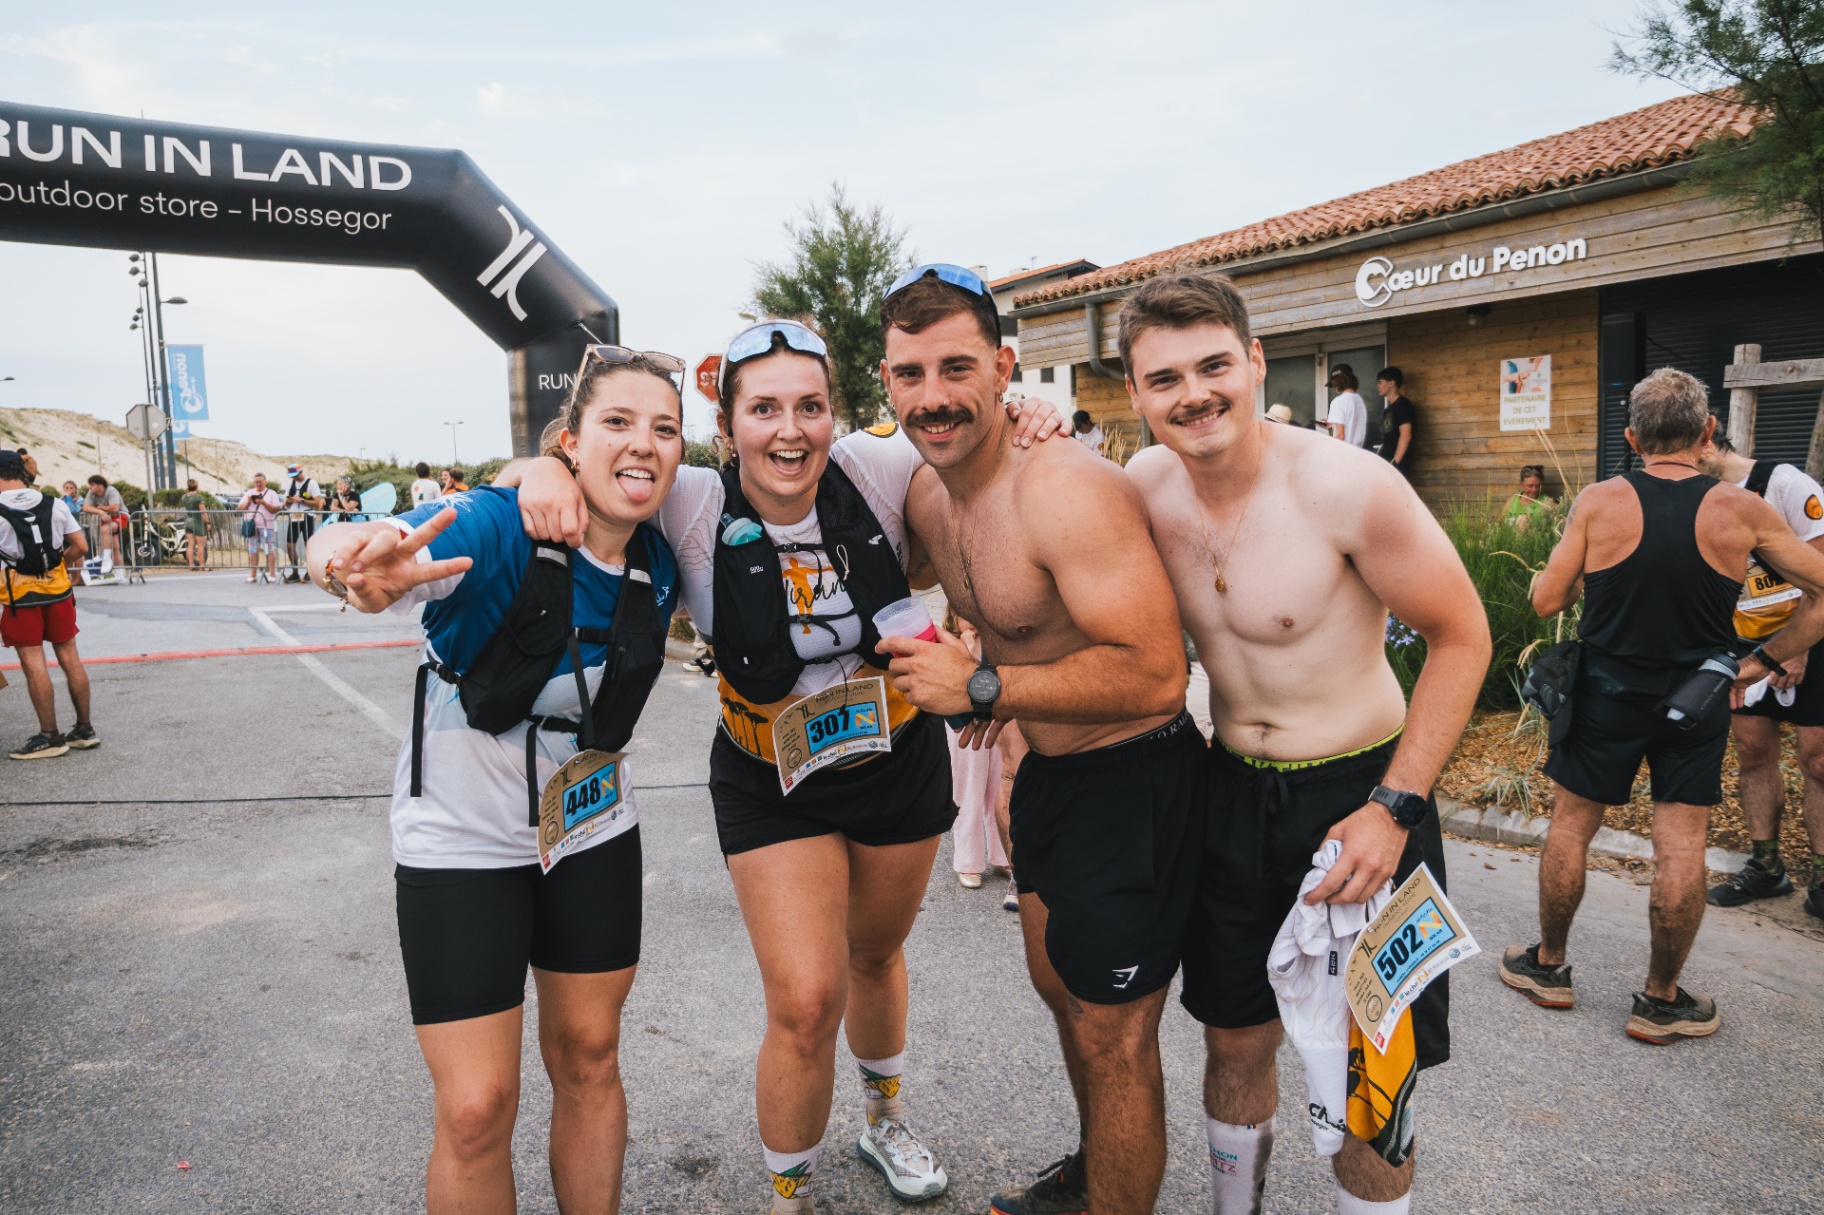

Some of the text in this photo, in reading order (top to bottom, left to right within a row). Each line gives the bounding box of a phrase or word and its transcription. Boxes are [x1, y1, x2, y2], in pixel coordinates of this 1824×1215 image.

[0, 119, 413, 191] UN IN LAND
[0, 180, 128, 211] outdoor
[139, 190, 219, 219] store
[251, 198, 392, 234] Hossegor
[1449, 252, 1485, 282] du
[1492, 237, 1587, 274] Penon
[538, 372, 577, 390] RUN
[700, 371, 718, 387] ST
[1503, 394, 1547, 404] PARTENAIRE
[1524, 406, 1537, 414] CET
[1503, 416, 1547, 426] EVENEMENT
[1754, 575, 1775, 591] 80
[809, 708, 850, 744] 307
[565, 777, 601, 816] 448
[1399, 878, 1421, 903] LAND
[1376, 923, 1424, 981] 502
